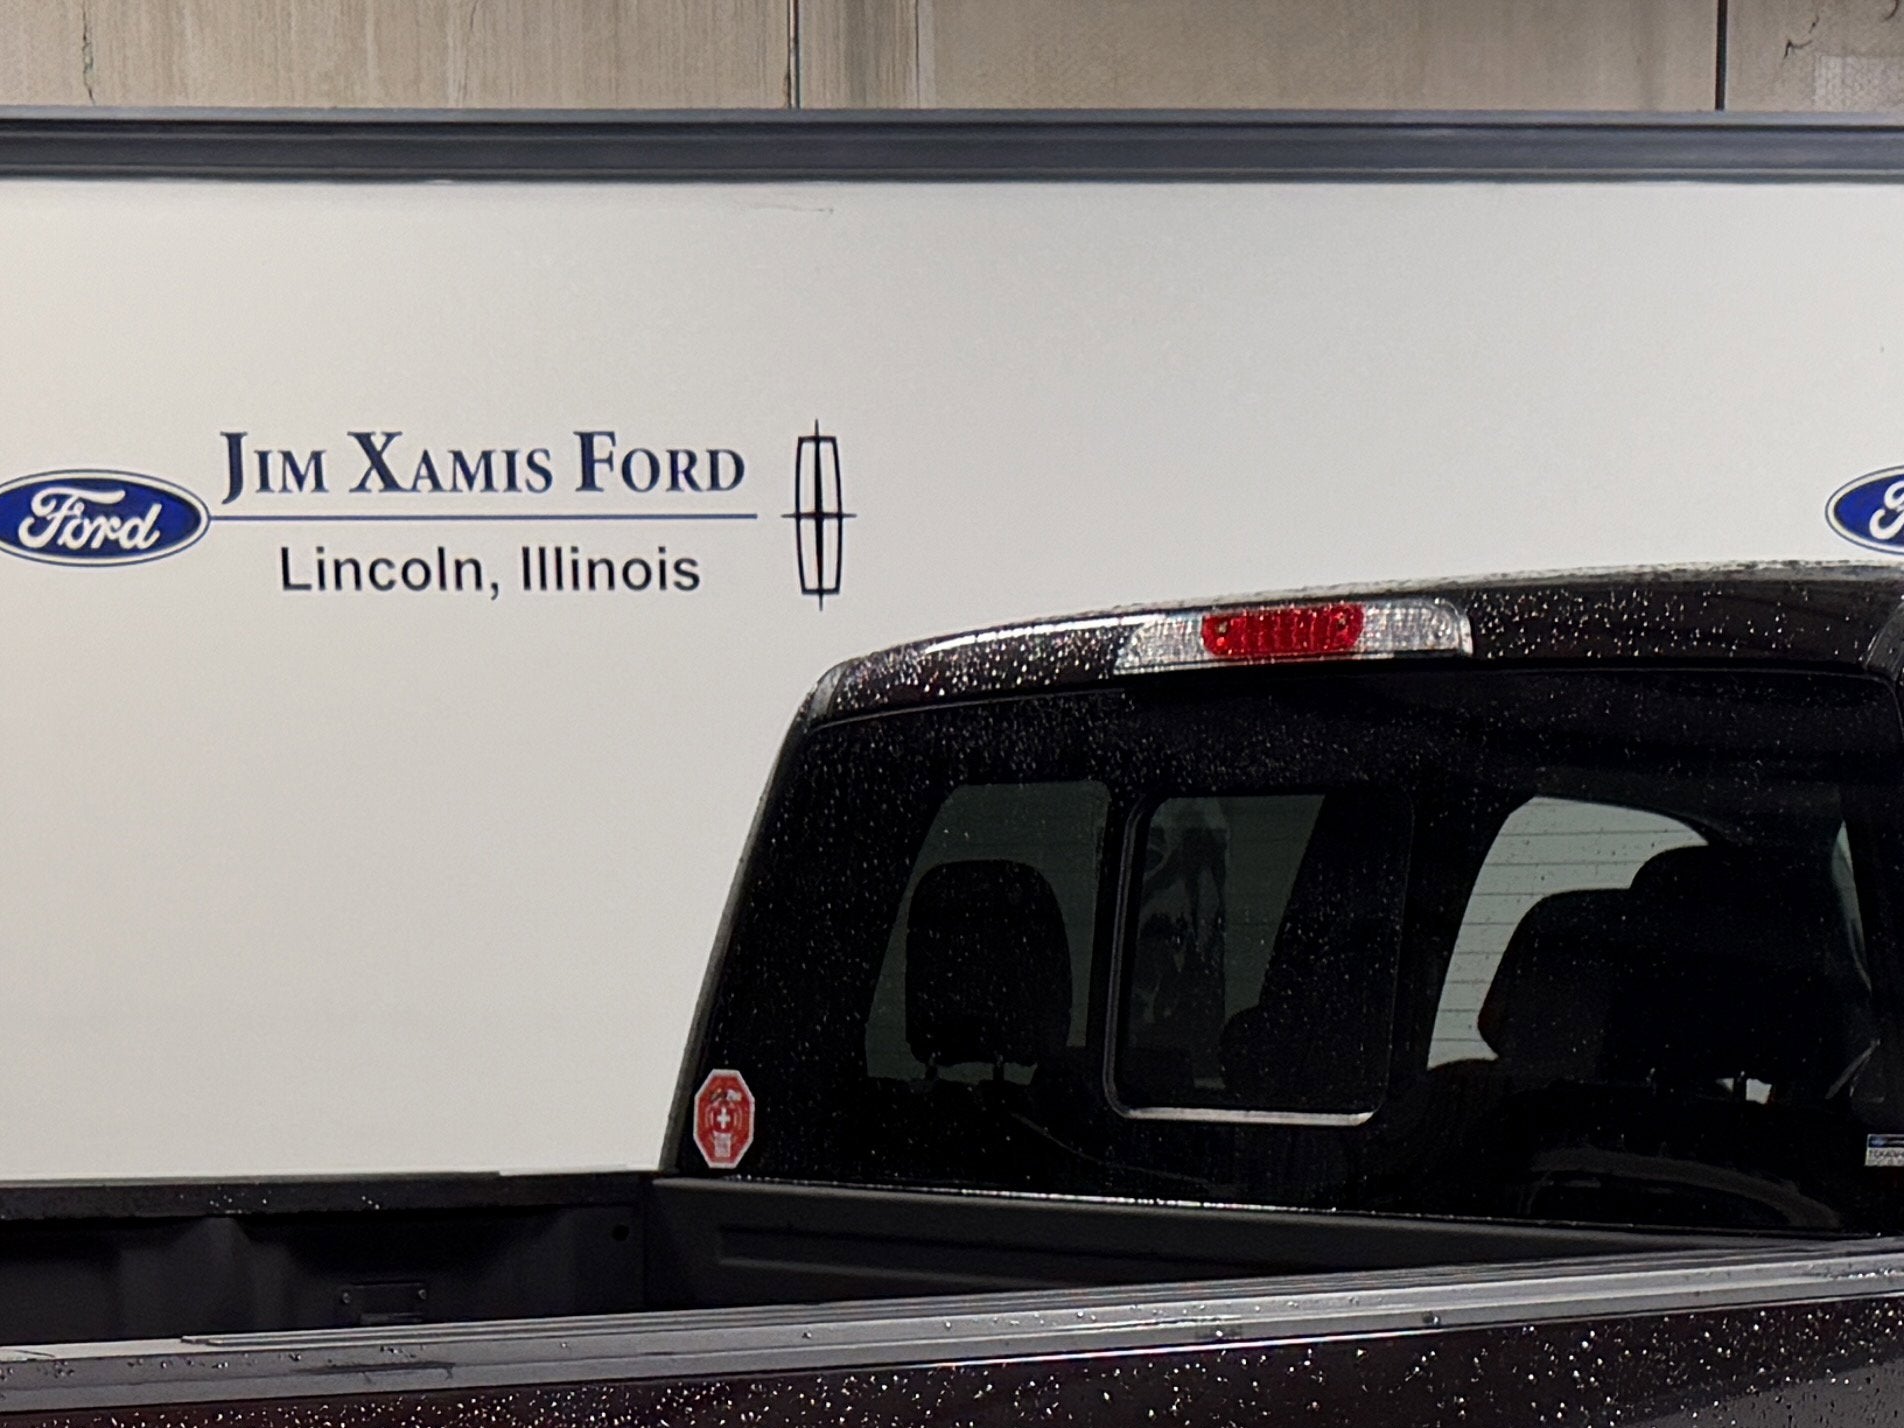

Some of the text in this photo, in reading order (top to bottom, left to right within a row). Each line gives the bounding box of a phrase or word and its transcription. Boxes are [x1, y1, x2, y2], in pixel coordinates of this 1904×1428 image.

[220, 430, 746, 506] JIM XAMIS FORD
[17, 485, 162, 552] Ford
[281, 545, 701, 601] Lincoln, Illinois
